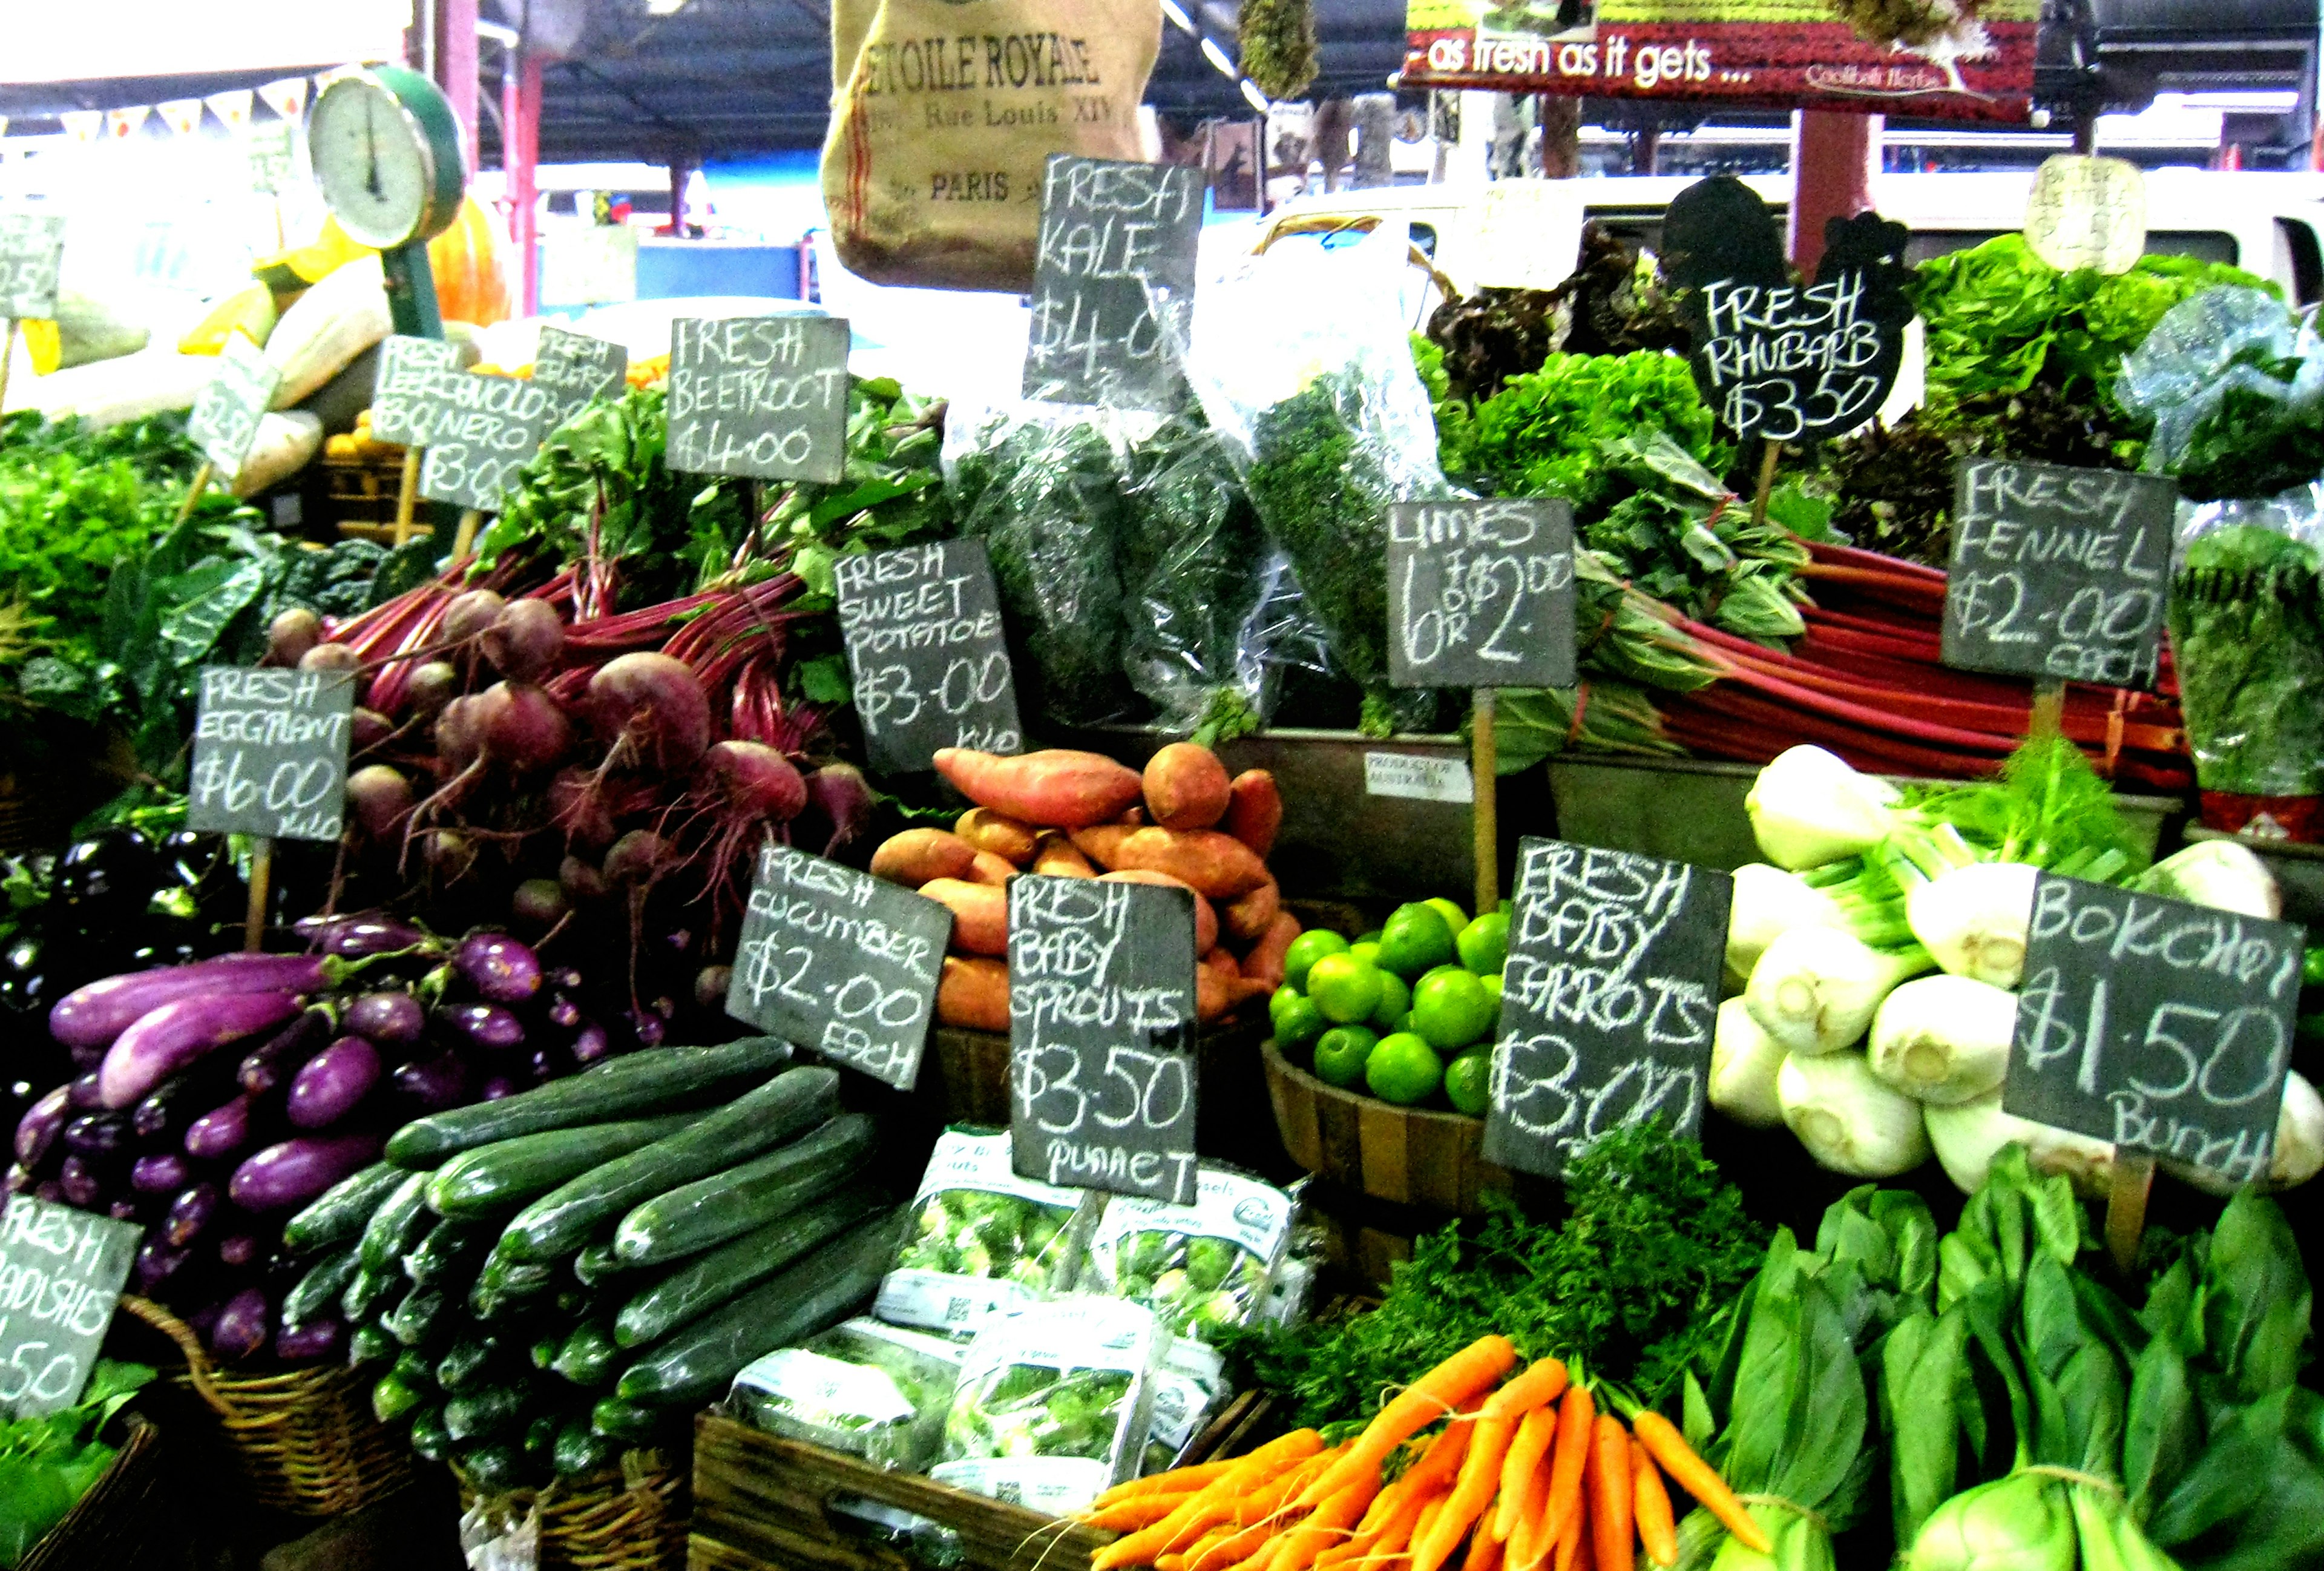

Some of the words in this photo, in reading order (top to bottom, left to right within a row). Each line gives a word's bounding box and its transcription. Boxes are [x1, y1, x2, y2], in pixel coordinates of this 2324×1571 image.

[983, 32, 1100, 88] ROYALE
[1427, 38, 1465, 71] as
[1472, 33, 1551, 74] fresh
[1558, 41, 1598, 77] as
[1605, 35, 1627, 78] it
[1633, 39, 1712, 89] gets
[984, 99, 1058, 127] Louis
[931, 171, 1009, 203] PARIS
[1042, 154, 1190, 223] FRESH
[1036, 213, 1163, 280] KALE
[1701, 265, 1865, 338] FRESH
[677, 318, 806, 368] FRESH
[1701, 320, 1881, 387] RHUBARB
[434, 409, 529, 451] NERO
[1965, 461, 2140, 530] FRESH
[834, 541, 945, 601] FRESH
[1955, 512, 2160, 581] FENNEL
[839, 574, 974, 630] SWEET
[1402, 554, 1443, 665] 6
[202, 667, 321, 709] FRESH
[761, 846, 876, 908] FRESH
[1009, 874, 1131, 935] FRESH
[1516, 843, 1692, 917] FRESH
[1009, 926, 1123, 987] BABY
[1501, 953, 1719, 1045] CARROTS
[2017, 966, 2286, 1107] $1.50
